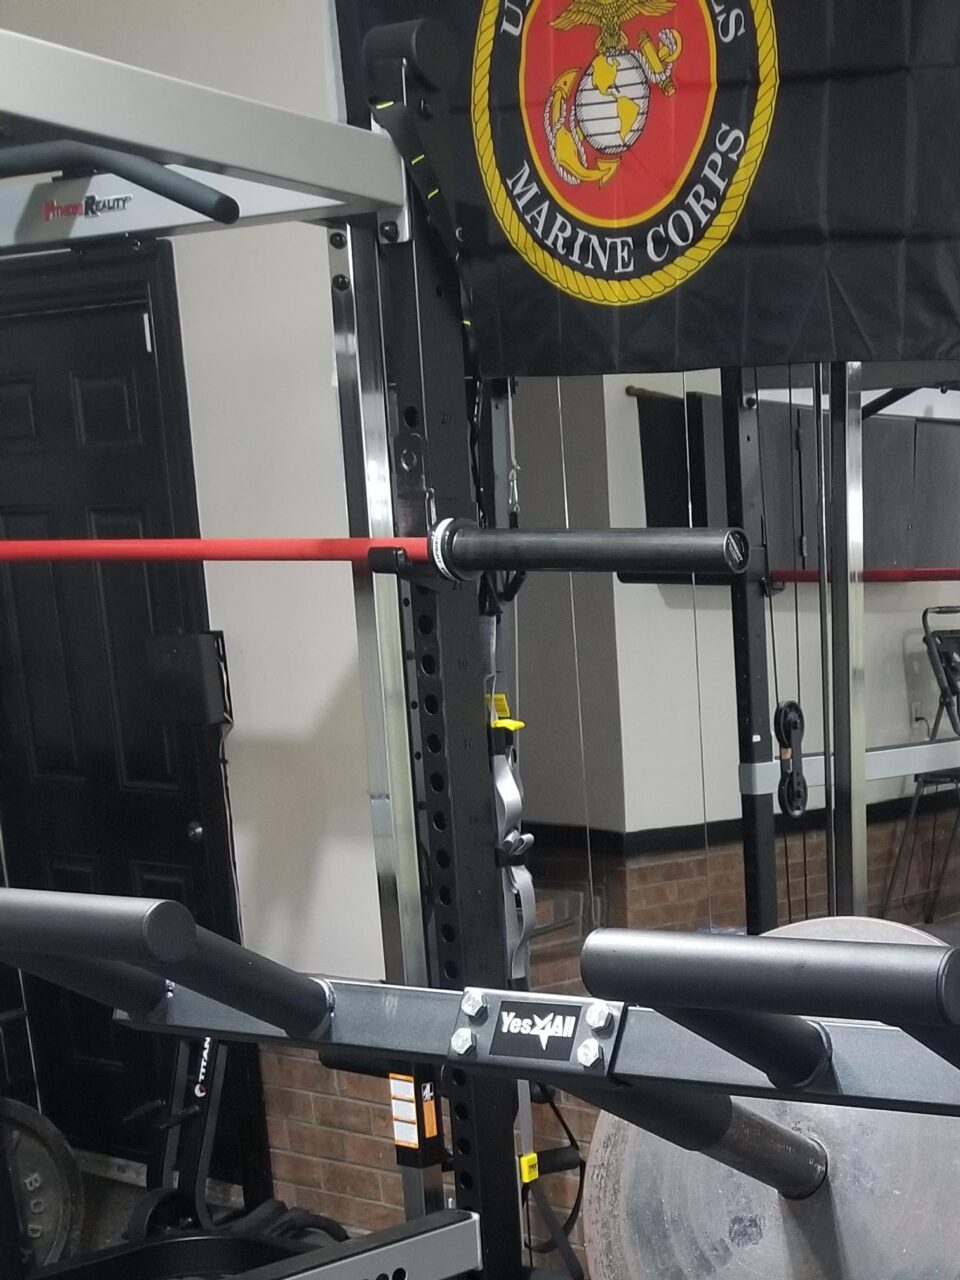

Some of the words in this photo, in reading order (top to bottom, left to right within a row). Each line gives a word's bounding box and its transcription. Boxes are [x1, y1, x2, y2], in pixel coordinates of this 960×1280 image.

[506, 160, 634, 273] MARINE
[646, 123, 745, 262] CORPS
[199, 1036, 211, 1082] TITAN
